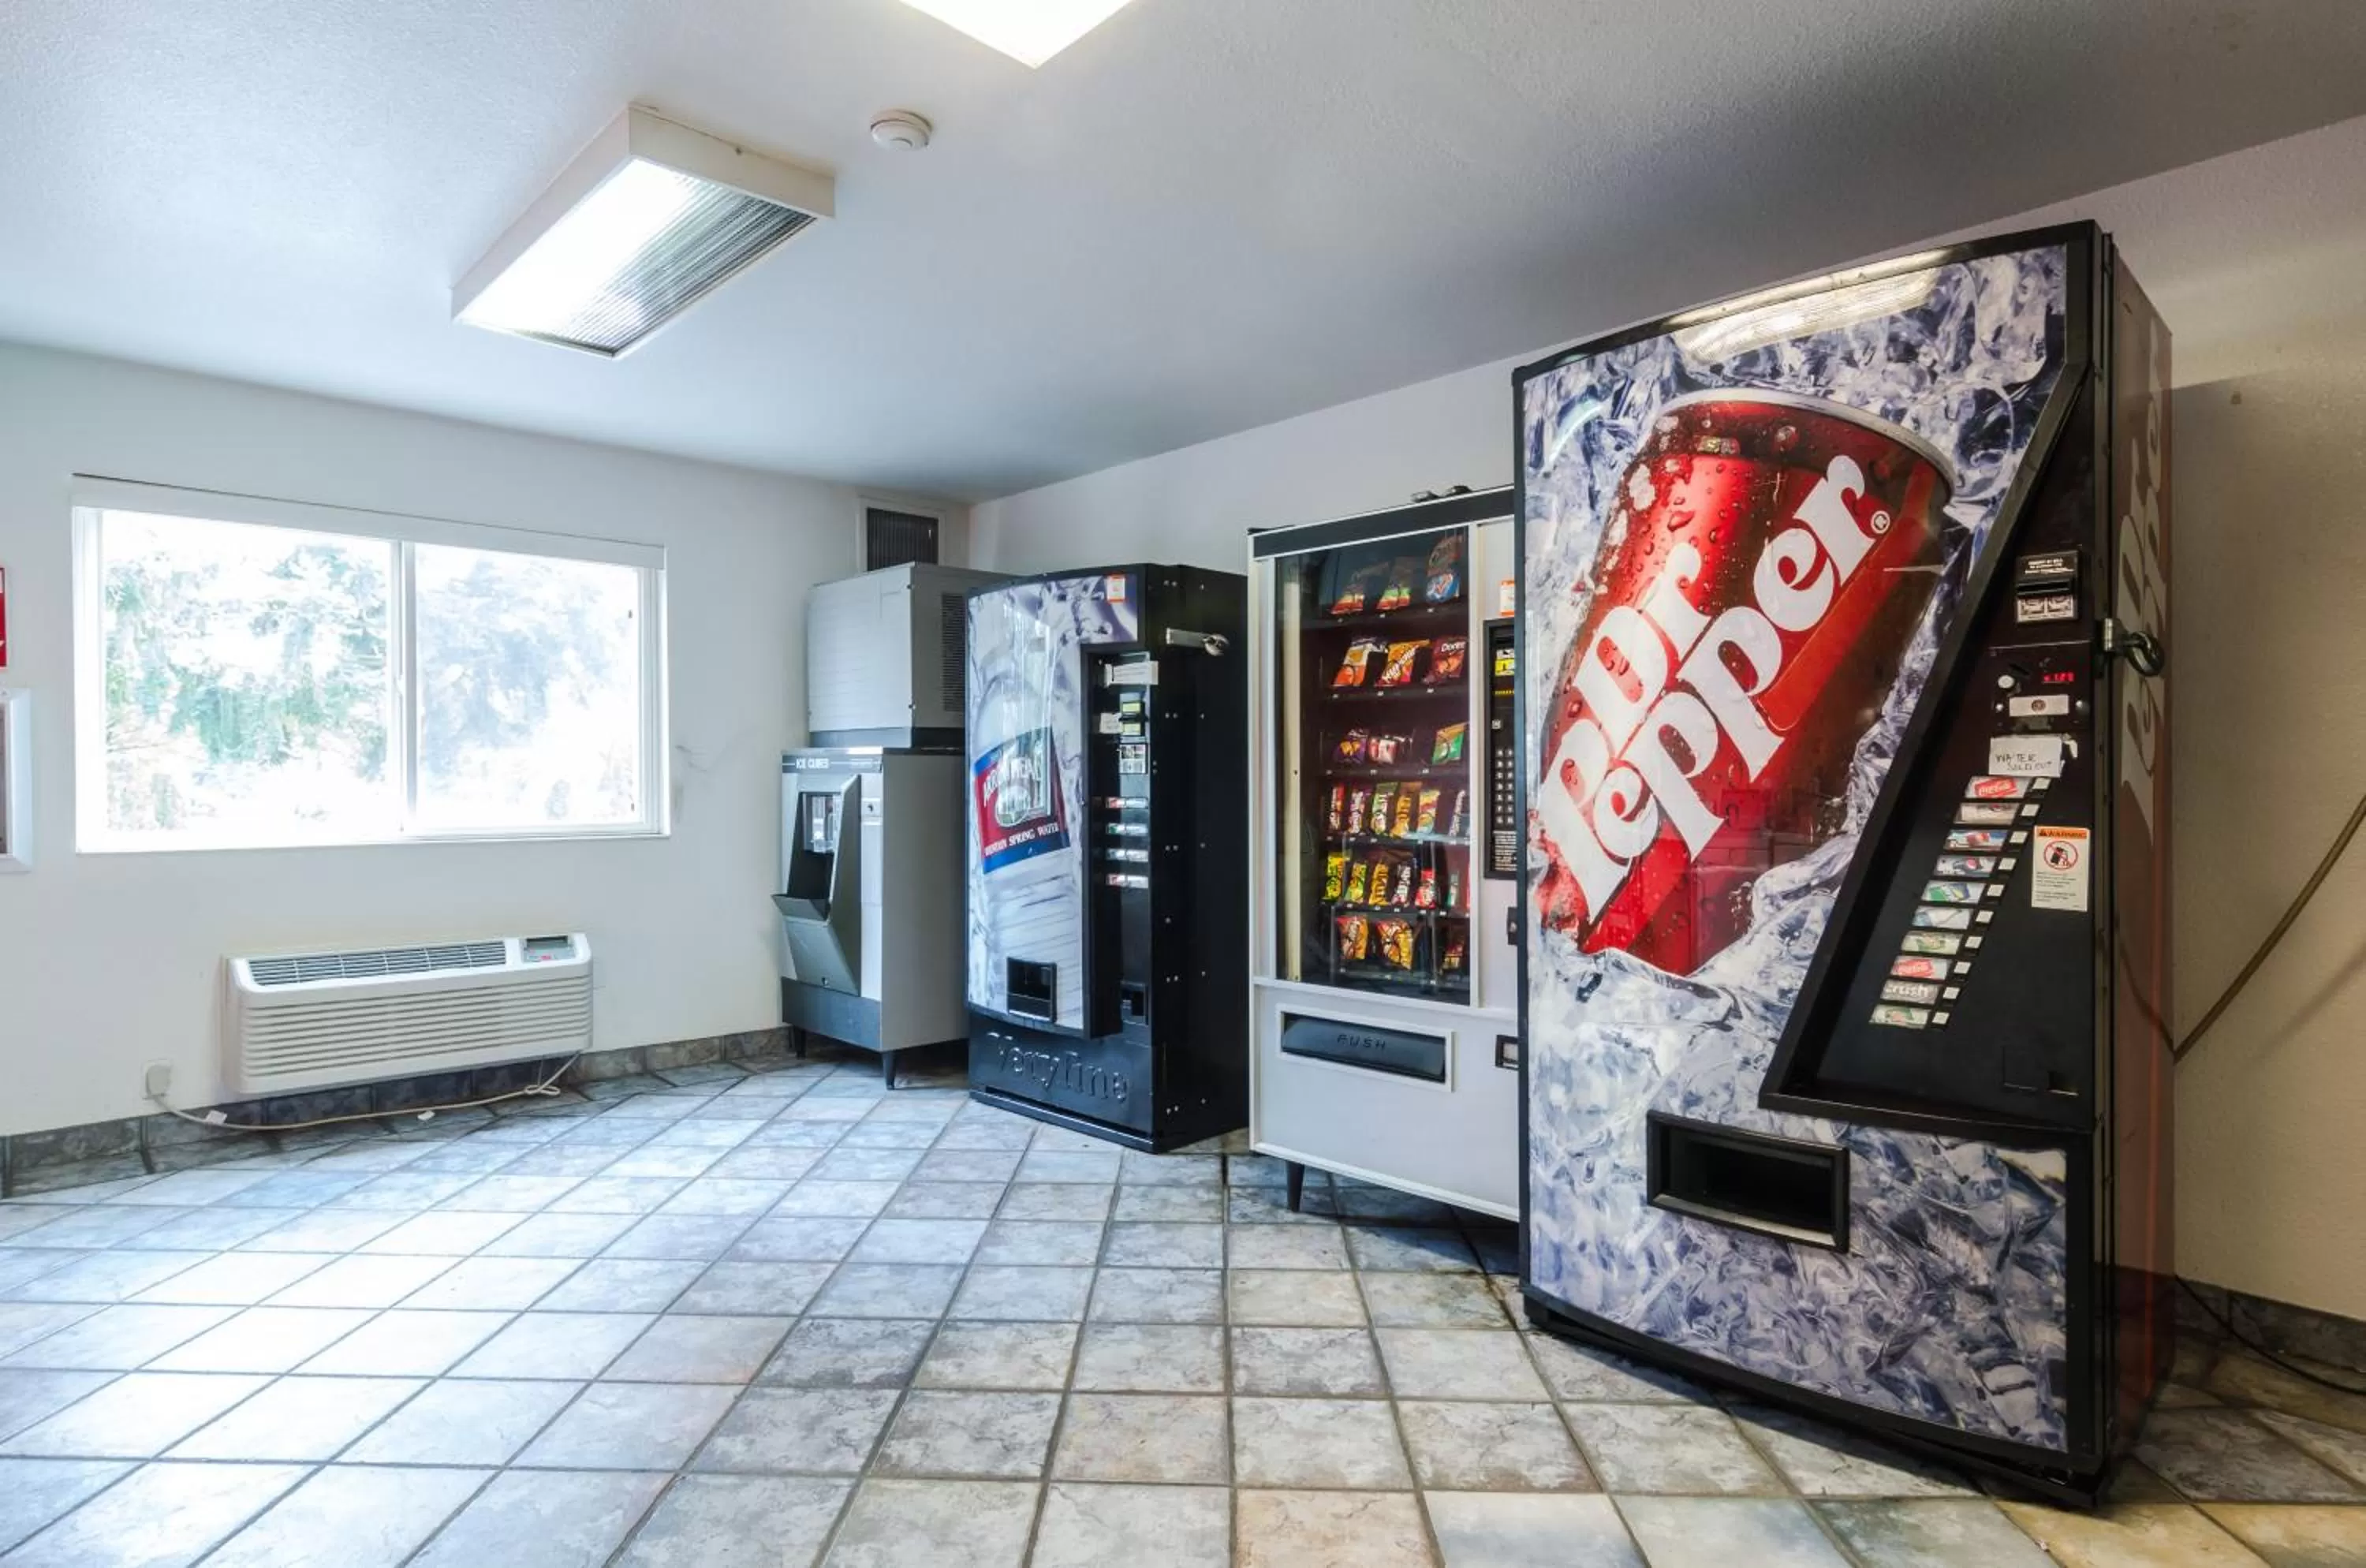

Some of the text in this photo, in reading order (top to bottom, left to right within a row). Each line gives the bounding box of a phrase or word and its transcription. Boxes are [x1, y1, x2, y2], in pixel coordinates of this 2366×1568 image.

[1573, 542, 1713, 760] Dr
[1540, 454, 1877, 925] Pepper
[1995, 752, 2037, 763] WATER
[1009, 827, 1036, 847] SPRING
[1337, 1034, 1386, 1049] PUSH
